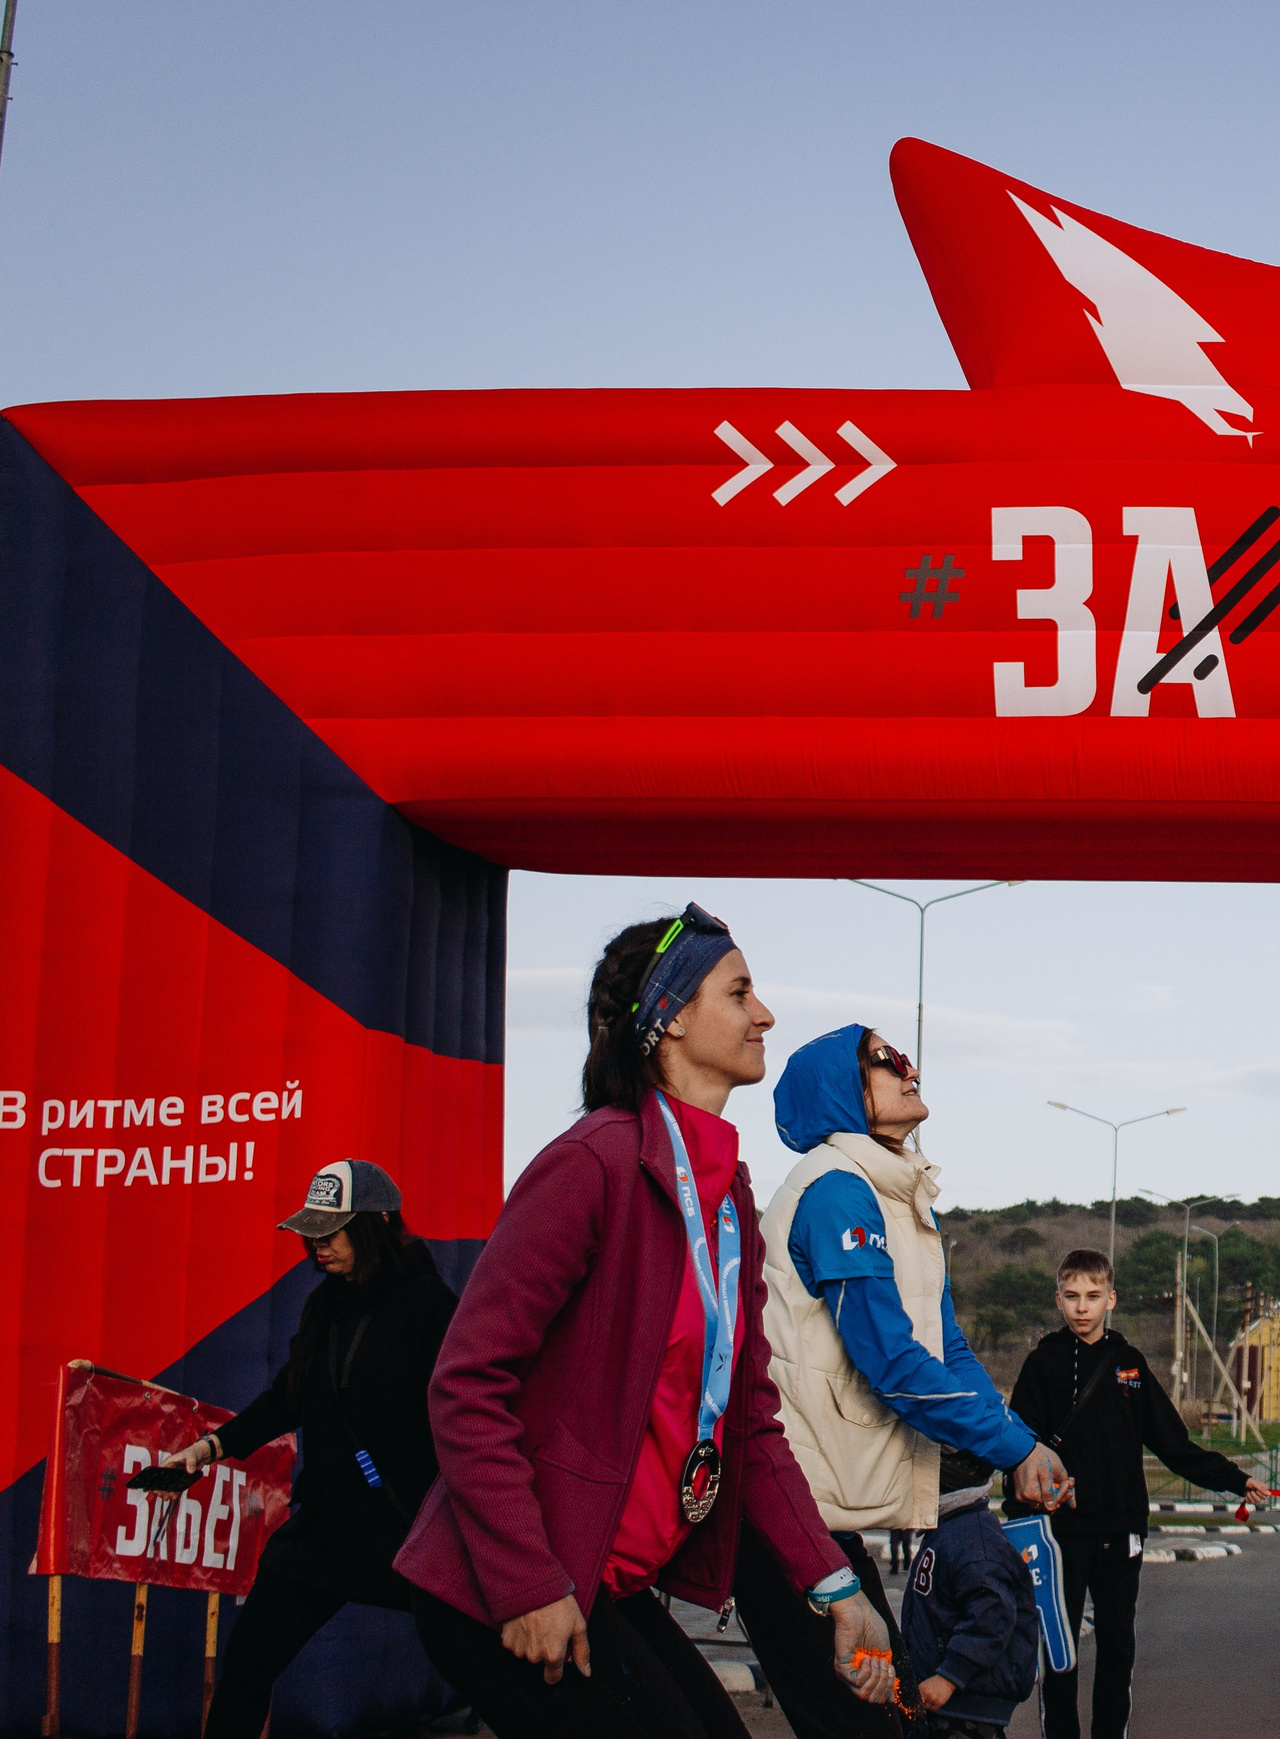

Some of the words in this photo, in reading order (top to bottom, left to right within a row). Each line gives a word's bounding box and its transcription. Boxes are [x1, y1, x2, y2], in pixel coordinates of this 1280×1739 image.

[0, 1090, 26, 1129] В
[41, 1096, 185, 1136] ритме
[201, 1079, 303, 1124] всей
[38, 1141, 256, 1188] СТРАНЫ!
[682, 1186, 696, 1217] ПСБ
[913, 1547, 936, 1596] B
